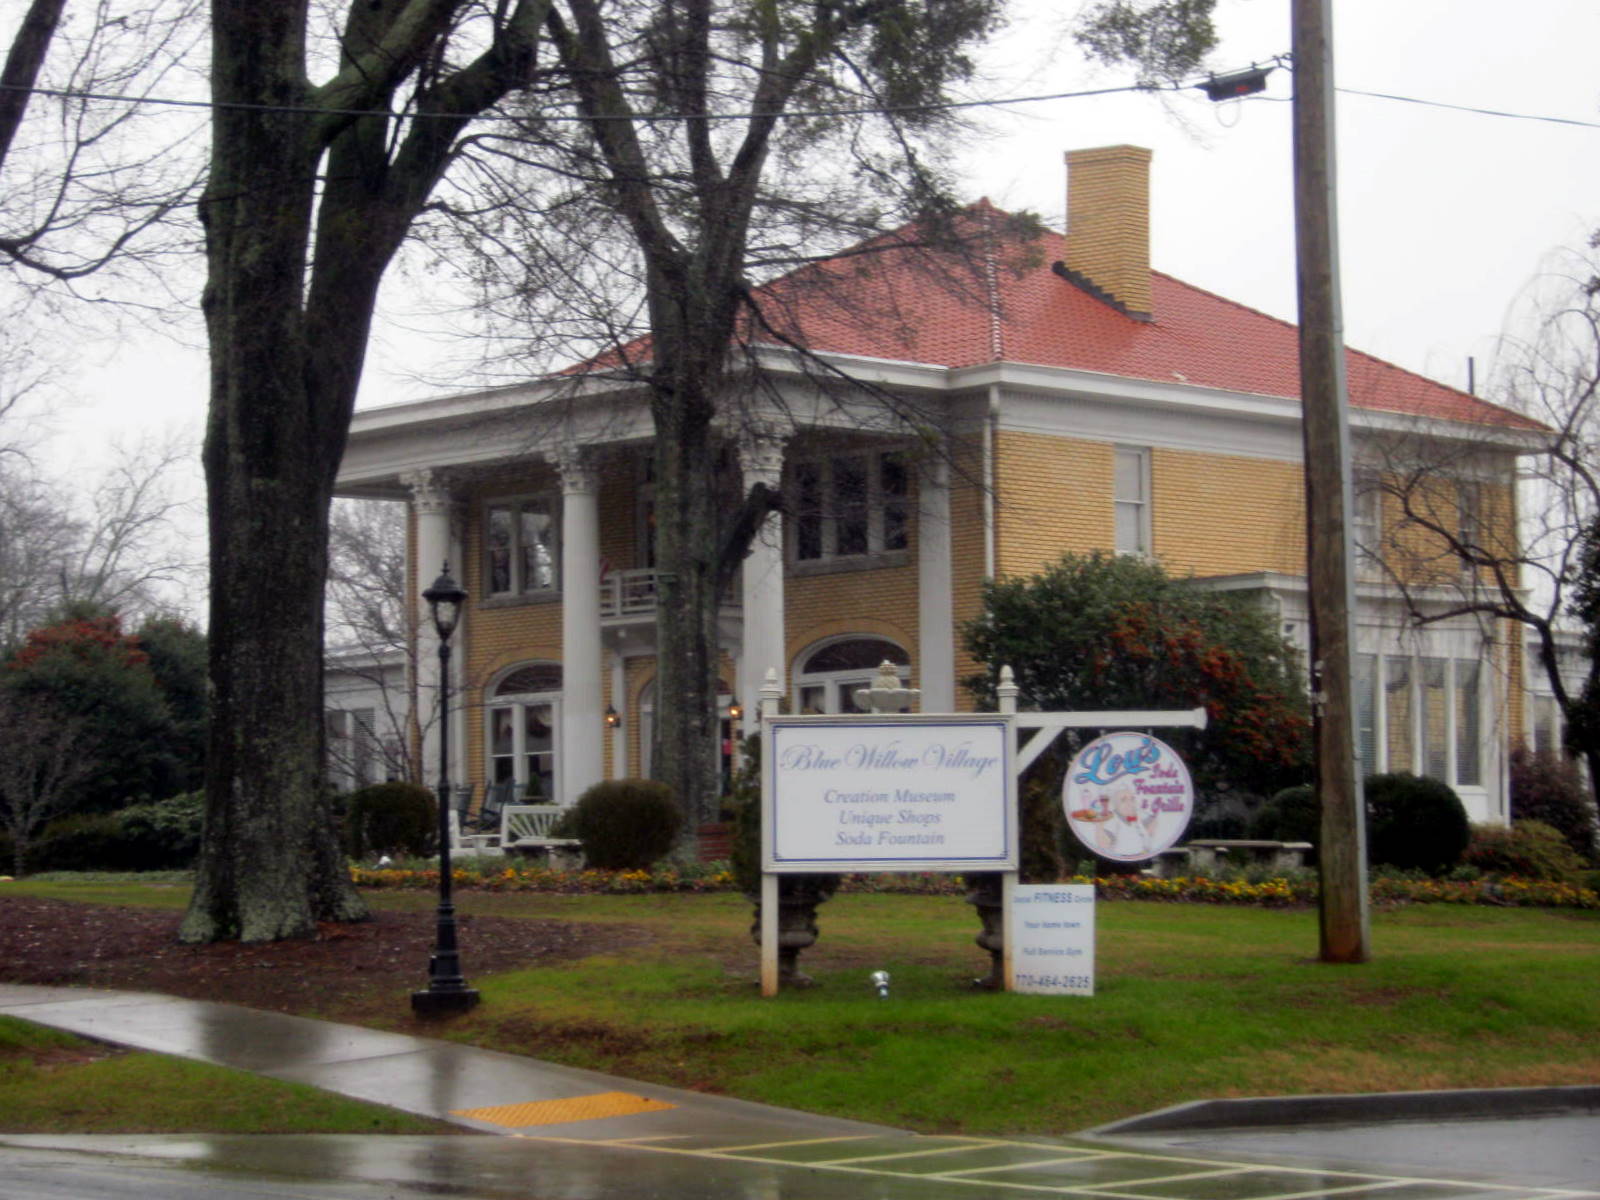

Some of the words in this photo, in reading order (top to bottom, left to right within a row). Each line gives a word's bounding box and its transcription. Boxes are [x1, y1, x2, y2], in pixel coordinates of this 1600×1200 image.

[780, 744, 840, 771] Blue
[843, 740, 918, 769] Willow
[922, 741, 998, 779] Village
[1074, 737, 1161, 785] Lou's
[1133, 779, 1185, 795] Fountain
[823, 788, 888, 804] Creation
[894, 788, 955, 803] Museum
[839, 810, 892, 827] Unique
[896, 809, 941, 827] Shops
[835, 831, 872, 845] Soda
[877, 830, 945, 845] Fountain
[1034, 892, 1073, 903] FITNESS
